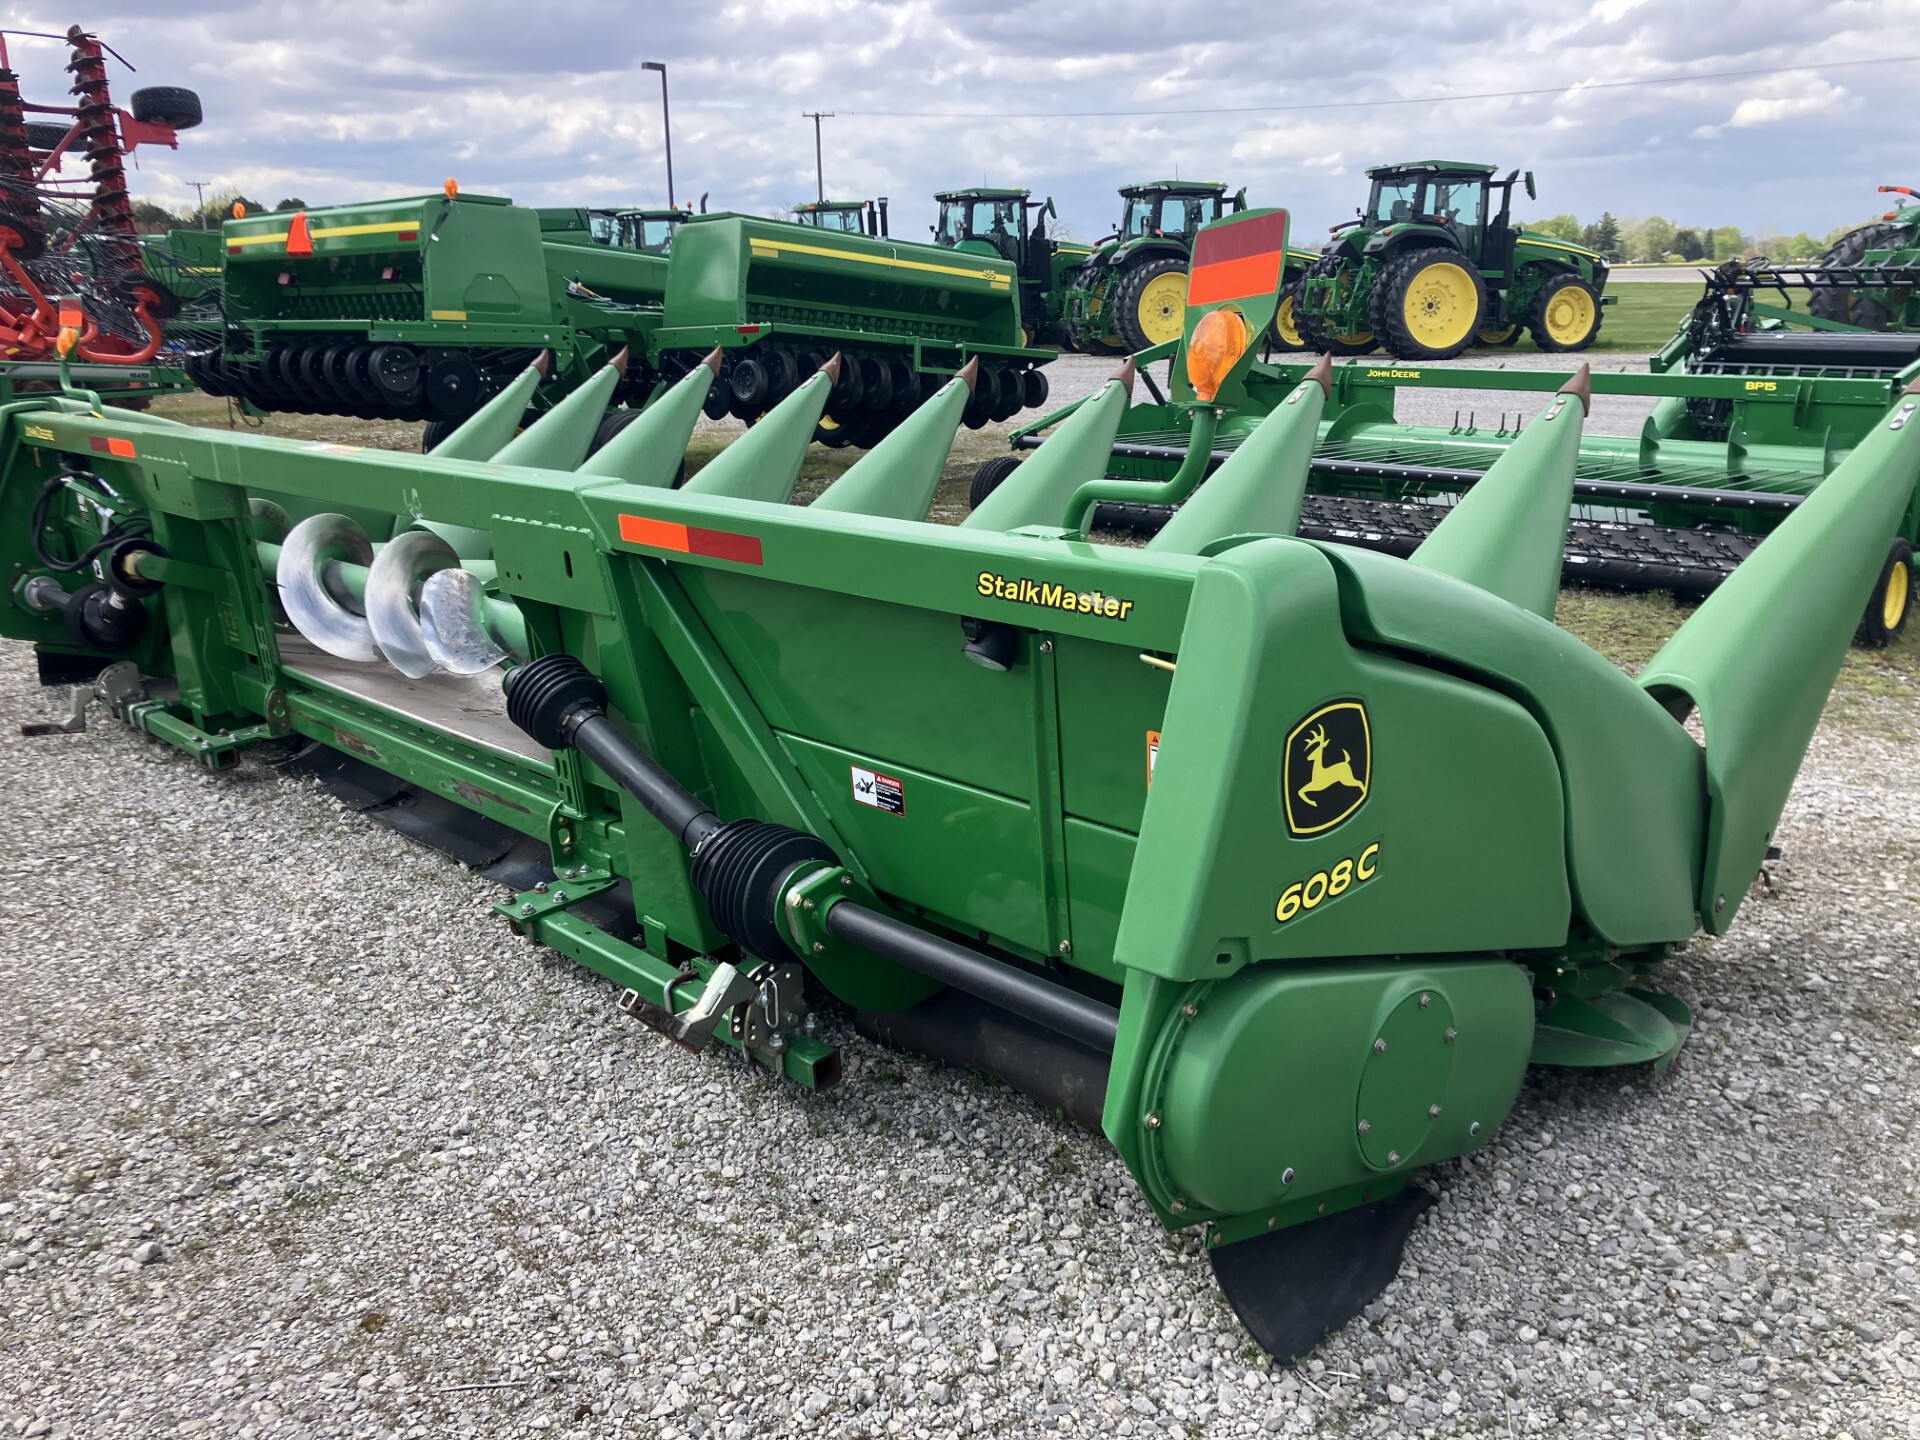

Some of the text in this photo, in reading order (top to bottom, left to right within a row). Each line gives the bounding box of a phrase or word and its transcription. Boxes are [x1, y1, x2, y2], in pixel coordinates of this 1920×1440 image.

[1367, 369, 1420, 379] JOHN DEERE
[1745, 381, 1777, 391] BP15
[977, 571, 1134, 620] StalkMaster
[1276, 842, 1379, 922] 608C
